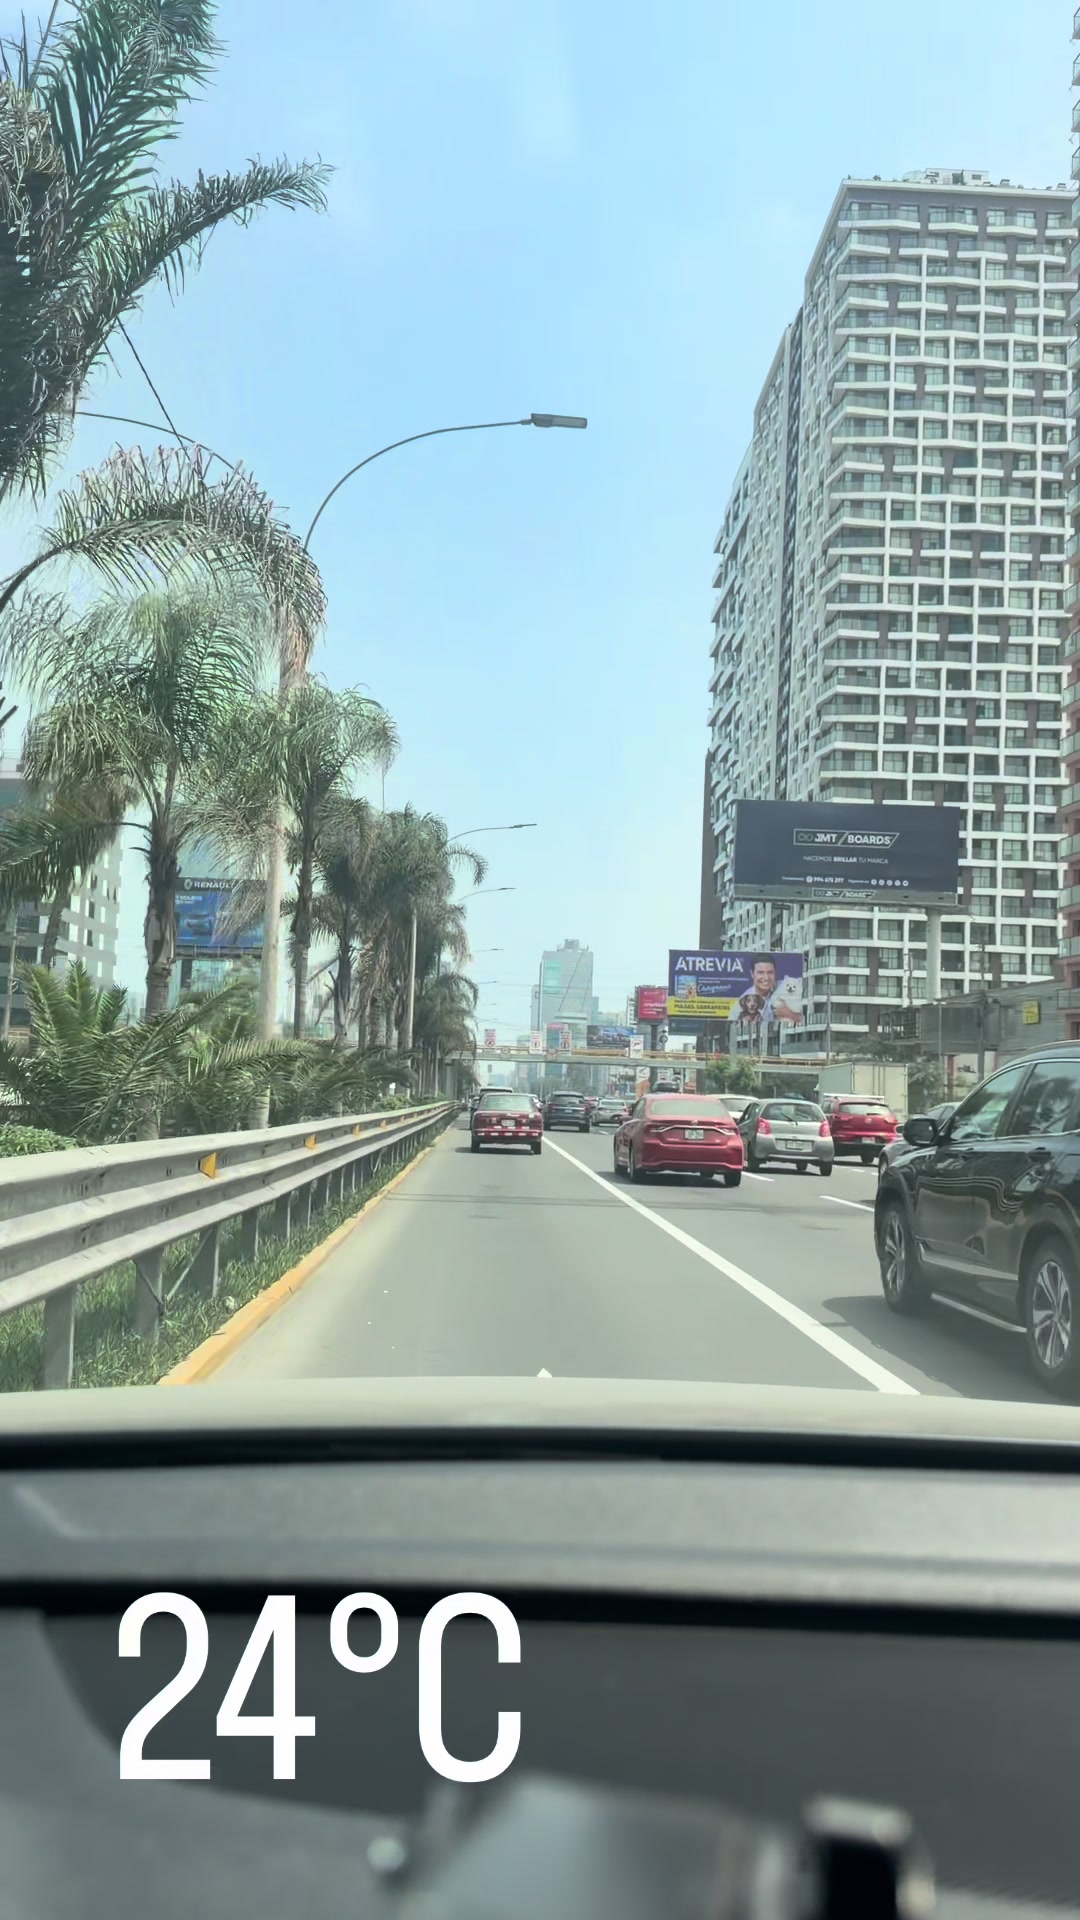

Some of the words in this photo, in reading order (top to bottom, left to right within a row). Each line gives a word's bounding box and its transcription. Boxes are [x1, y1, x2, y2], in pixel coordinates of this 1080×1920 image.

[815, 833, 837, 843] JMT
[847, 835, 891, 845] BOARDS
[675, 957, 743, 972] ATREVIA
